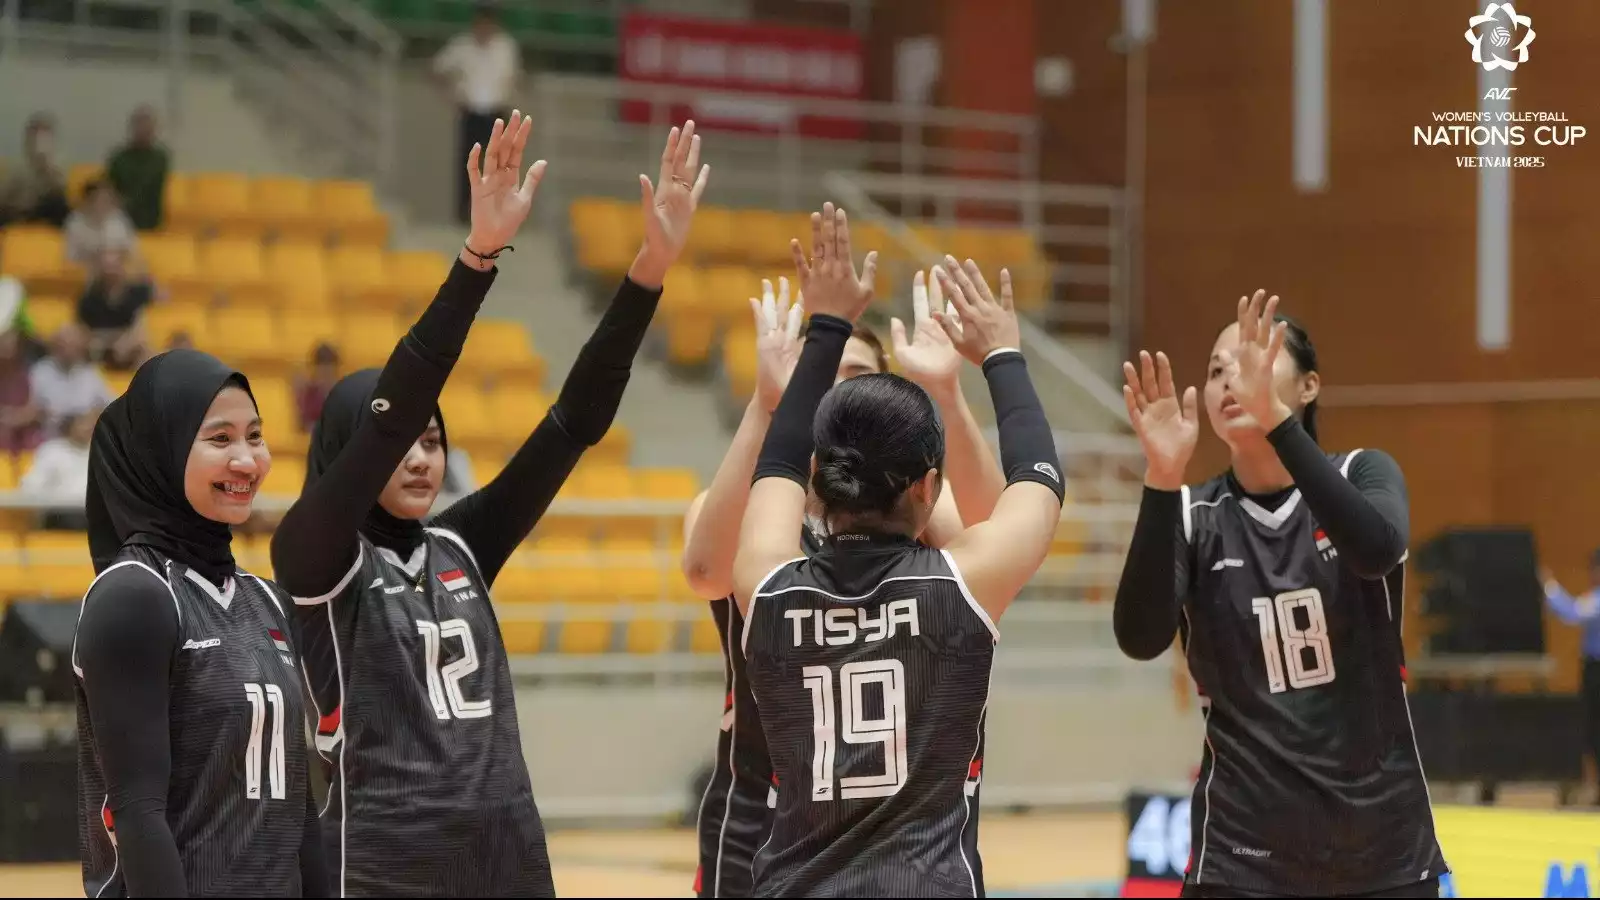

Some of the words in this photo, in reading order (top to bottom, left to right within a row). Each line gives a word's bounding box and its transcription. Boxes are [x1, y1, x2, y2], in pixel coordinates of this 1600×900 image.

[453, 590, 478, 603] INA
[784, 598, 920, 647] TISYA
[1251, 587, 1336, 694] 18
[415, 618, 492, 720] 12
[243, 682, 286, 800] 11
[802, 658, 909, 802] 19
